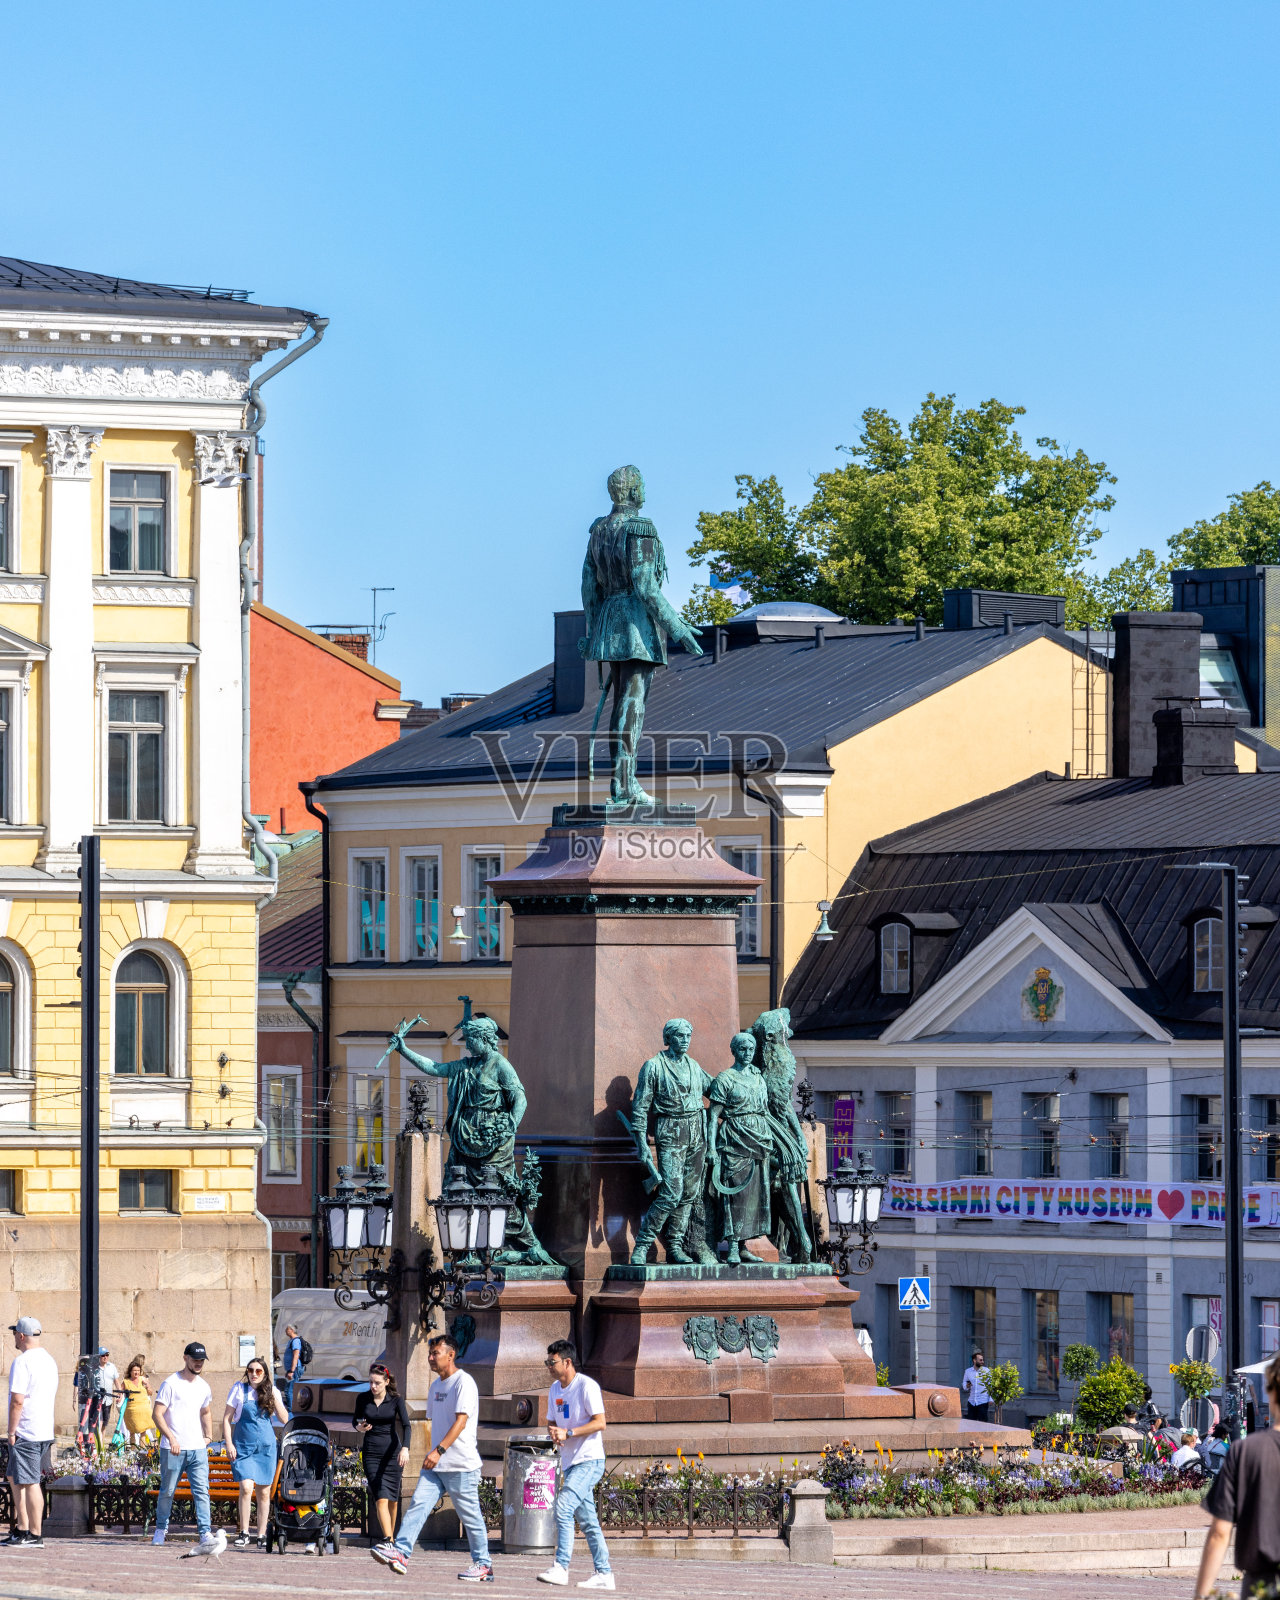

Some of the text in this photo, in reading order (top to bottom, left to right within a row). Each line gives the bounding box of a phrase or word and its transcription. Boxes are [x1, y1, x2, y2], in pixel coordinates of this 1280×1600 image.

[891, 1185, 990, 1214] HELSINKI
[996, 1186, 1054, 1216] CITY
[1058, 1187, 1152, 1217] MUSEUM
[1191, 1190, 1260, 1222] PRIE
